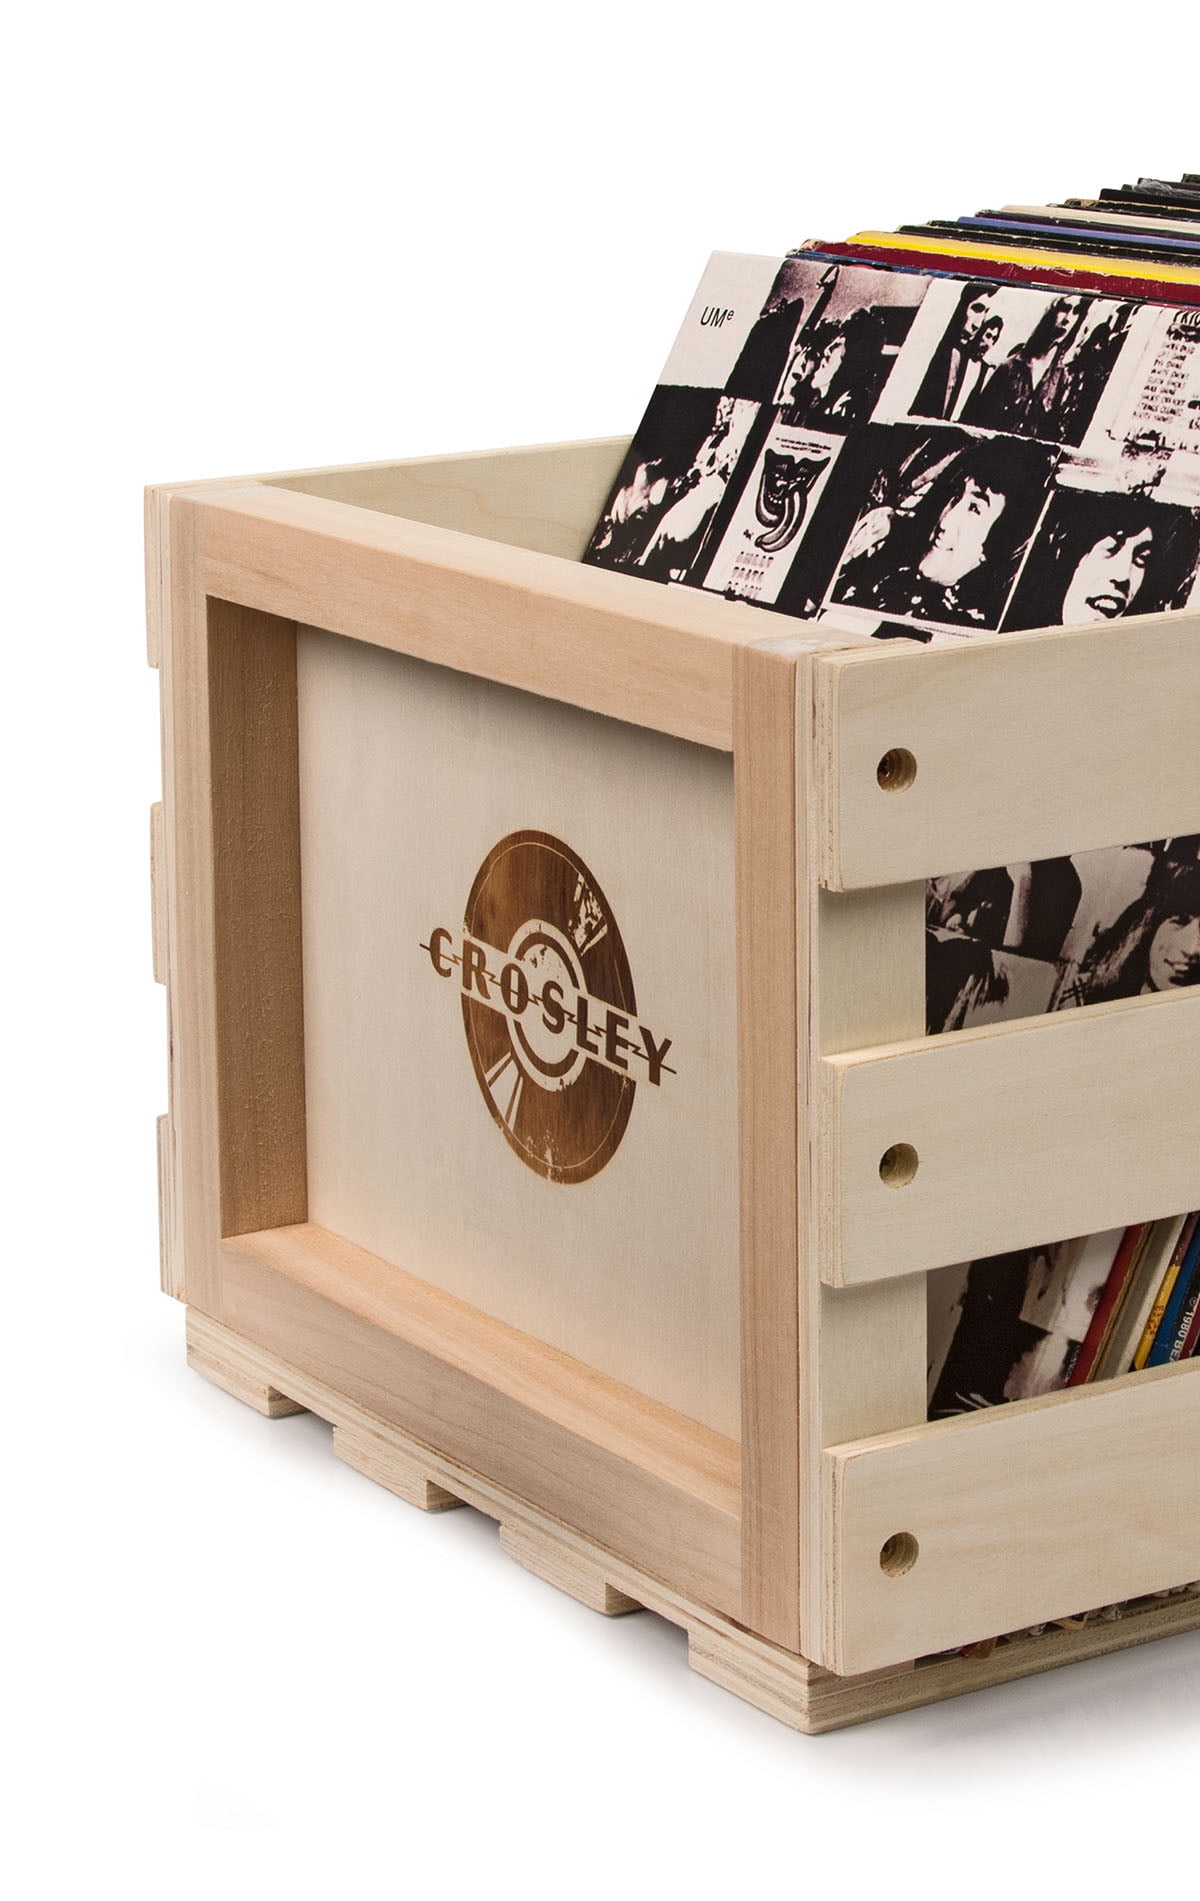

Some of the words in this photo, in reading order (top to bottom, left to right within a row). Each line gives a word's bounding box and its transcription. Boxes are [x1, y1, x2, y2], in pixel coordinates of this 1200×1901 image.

[700, 306, 734, 328] UMe
[427, 926, 674, 1087] CROSLEY
[1177, 1310, 1193, 1338] 1980
